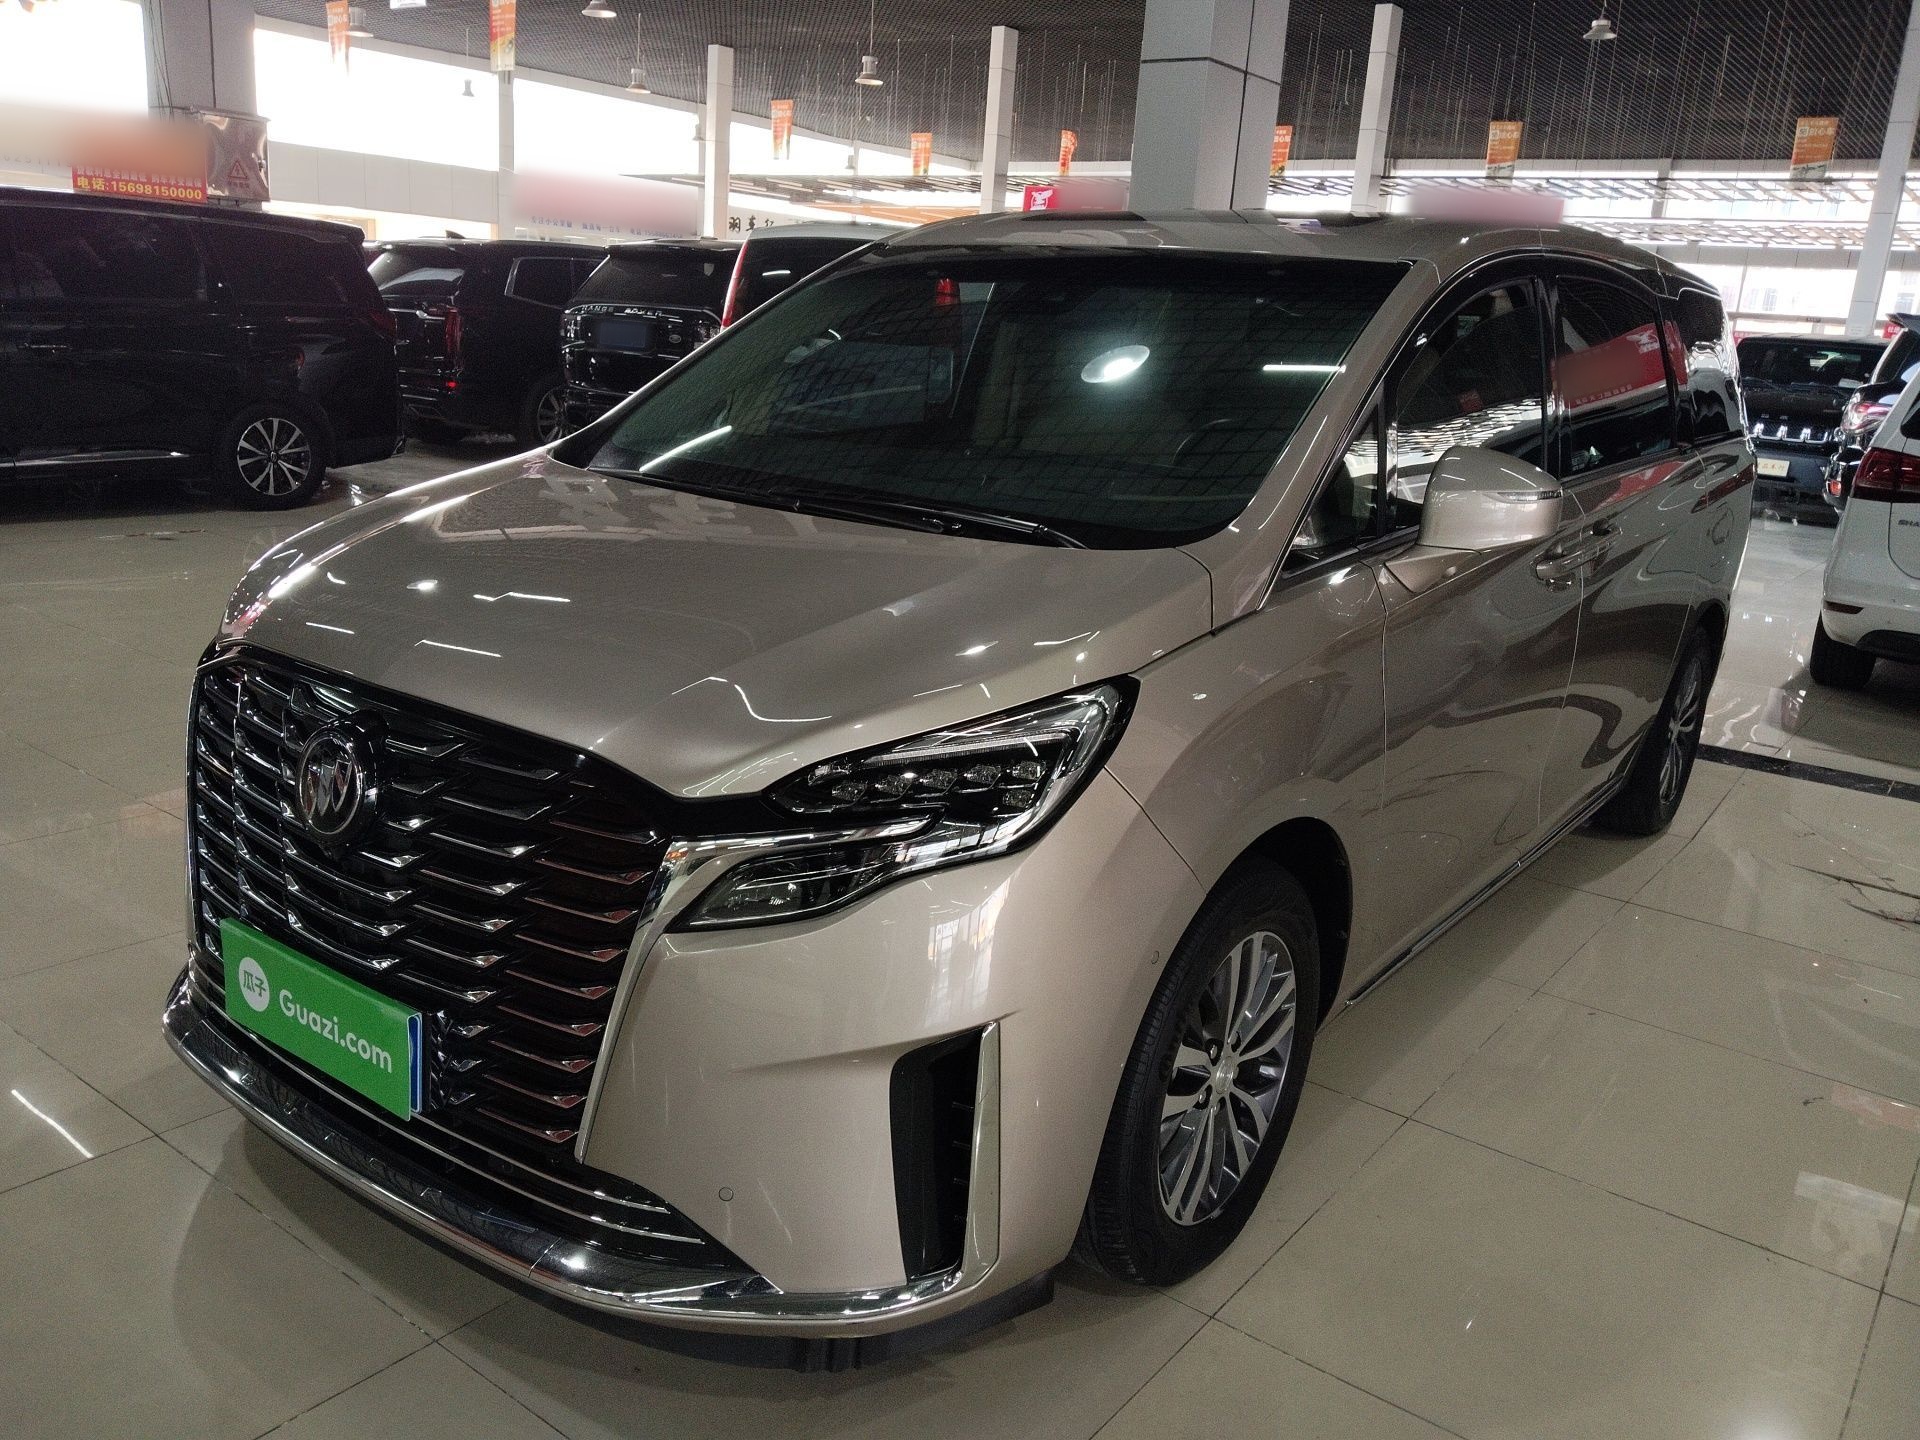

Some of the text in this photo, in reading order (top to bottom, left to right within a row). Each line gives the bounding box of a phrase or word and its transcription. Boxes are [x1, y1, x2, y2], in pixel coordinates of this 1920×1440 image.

[77, 176, 202, 200] 电话:15698150000
[243, 970, 266, 998] 瓜子
[279, 989, 392, 1073] Guazi.com
